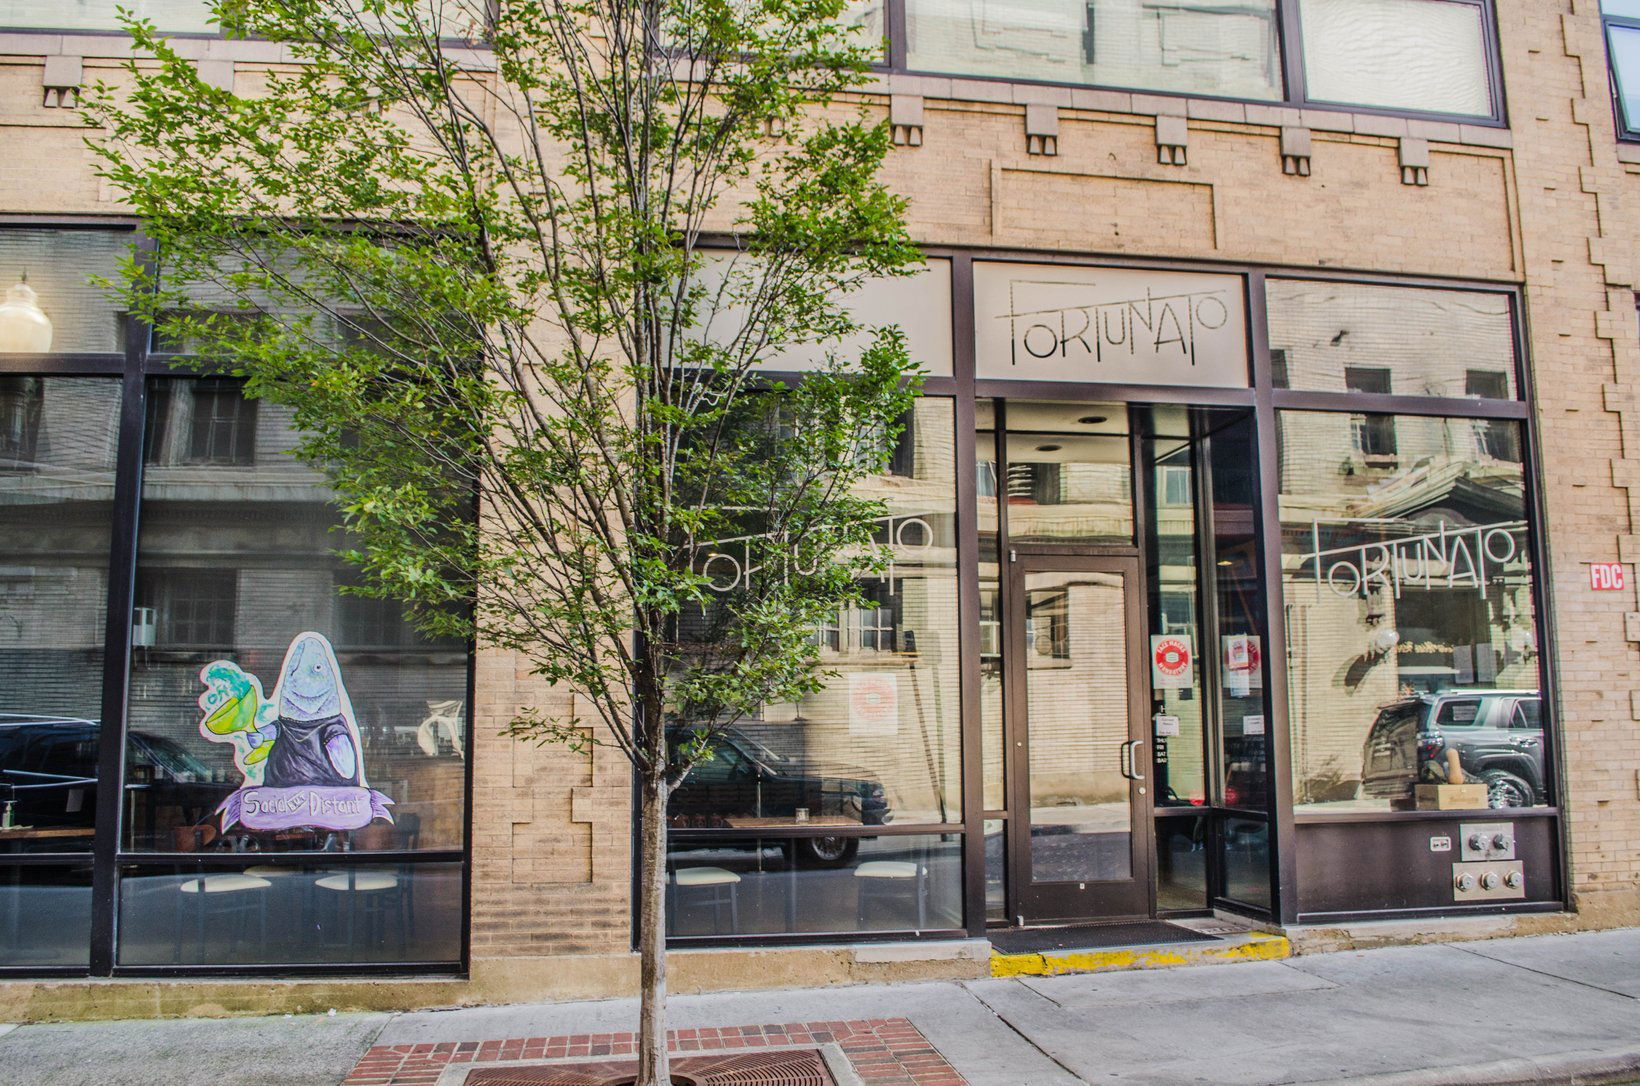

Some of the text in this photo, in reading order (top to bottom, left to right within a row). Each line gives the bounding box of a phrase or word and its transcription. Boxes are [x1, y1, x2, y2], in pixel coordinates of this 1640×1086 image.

[994, 279, 1227, 366] FORTUNATO
[1301, 517, 1528, 602] FORTUNATO
[1591, 564, 1623, 589] FDC
[309, 790, 360, 817] Distant
